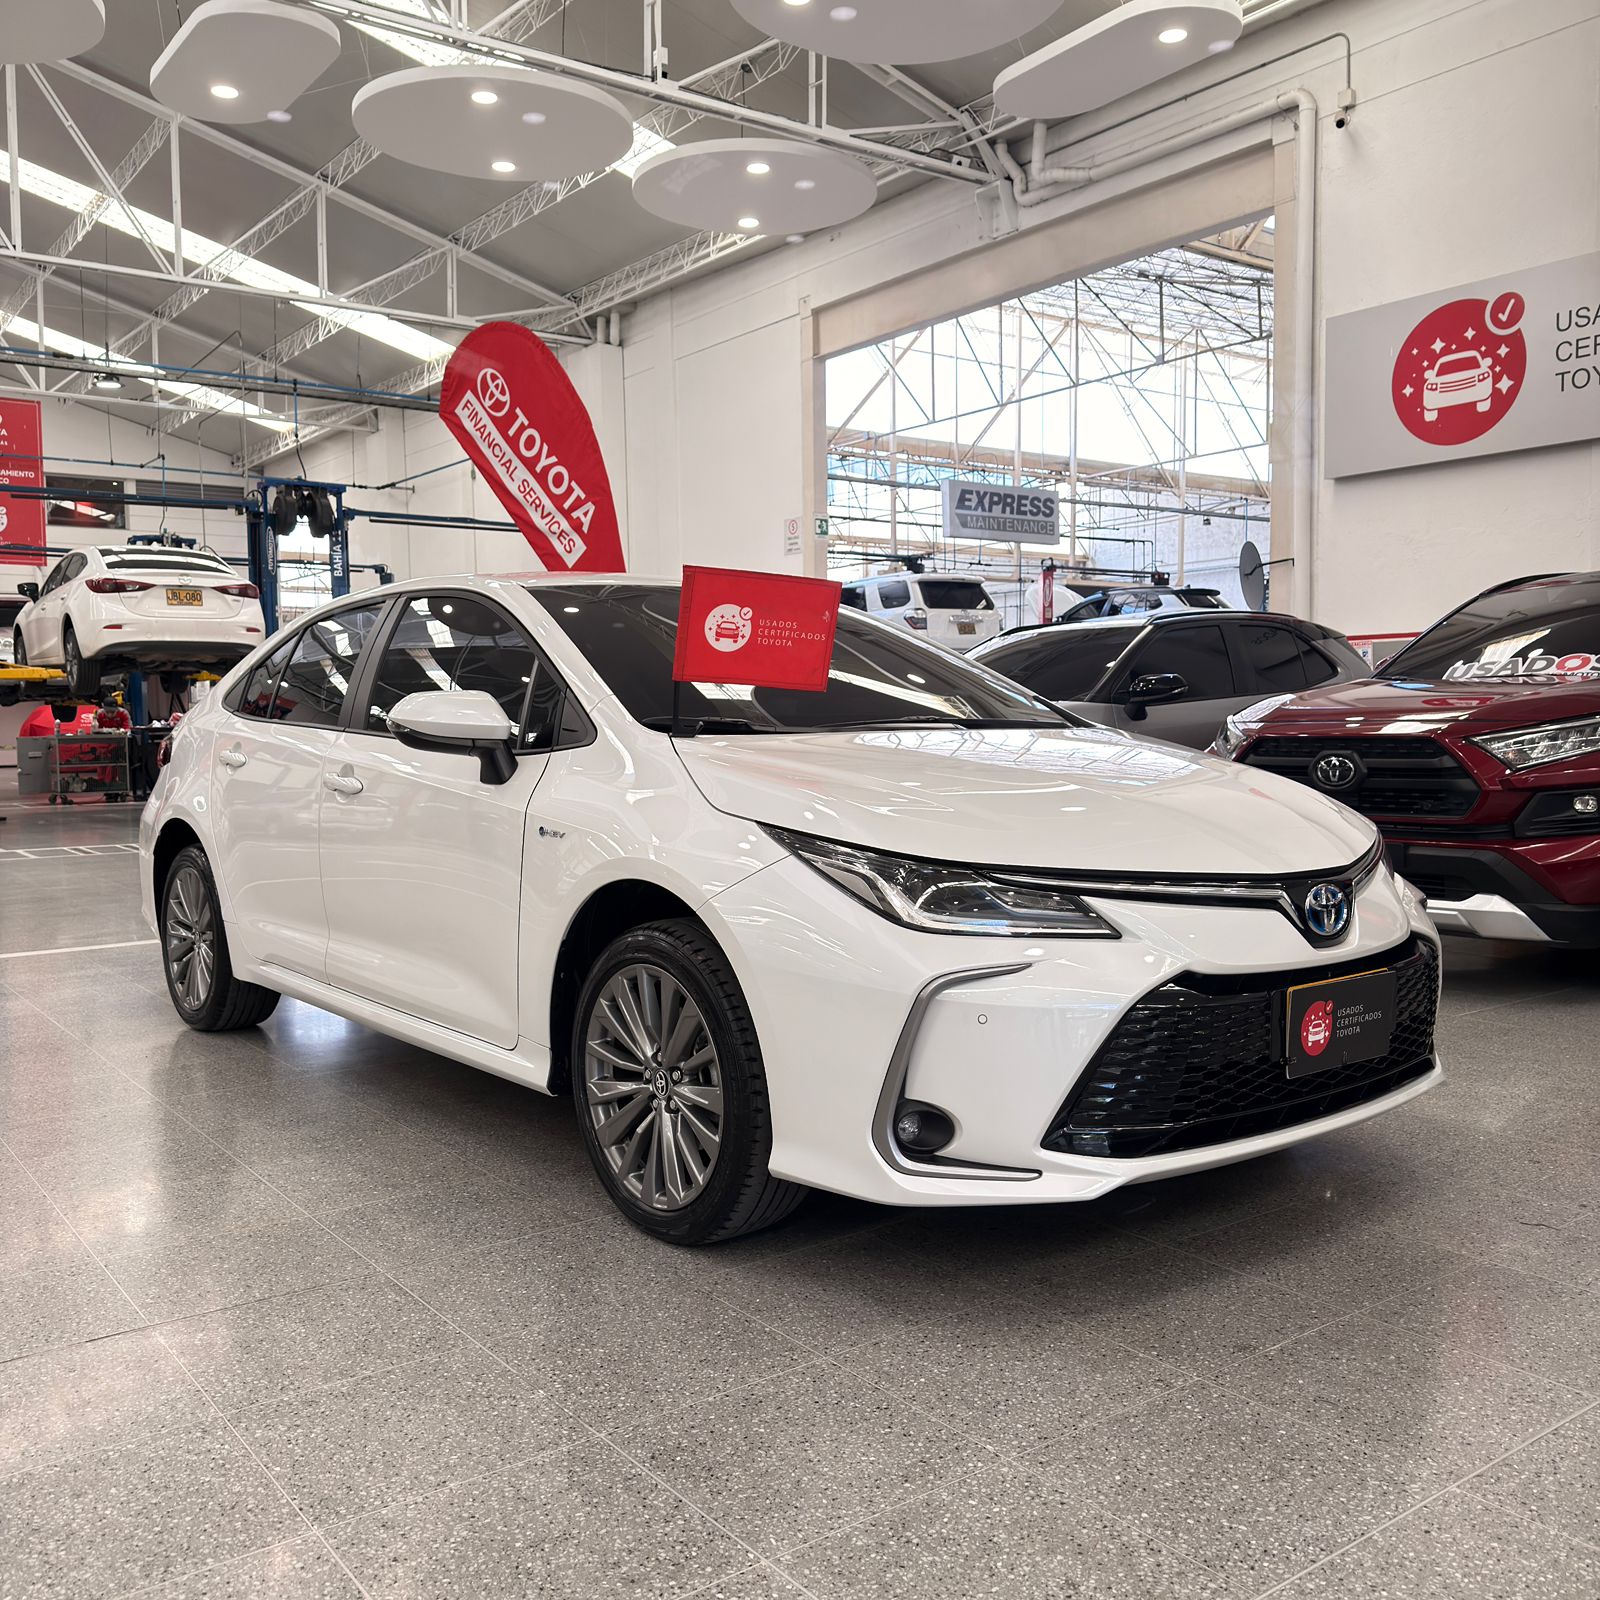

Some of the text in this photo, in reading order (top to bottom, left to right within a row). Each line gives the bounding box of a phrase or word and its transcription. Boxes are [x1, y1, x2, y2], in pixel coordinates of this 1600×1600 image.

[0, 469, 35, 478] AMIENTO
[461, 398, 576, 555] FINANCIAL SERVICES
[507, 407, 595, 534] TOYOTA
[955, 488, 1055, 518] EXPRESS
[967, 516, 1054, 535] MAINTENANCE
[331, 544, 343, 577] BAHÍA
[759, 619, 798, 629] USADOS
[757, 637, 793, 647] TOYOTA
[758, 628, 826, 641] CERTIFICADOS
[1337, 1004, 1364, 1017] USADOS
[1336, 1010, 1382, 1028] CERTIFICADOS
[1336, 1025, 1361, 1038] TOYOTA
